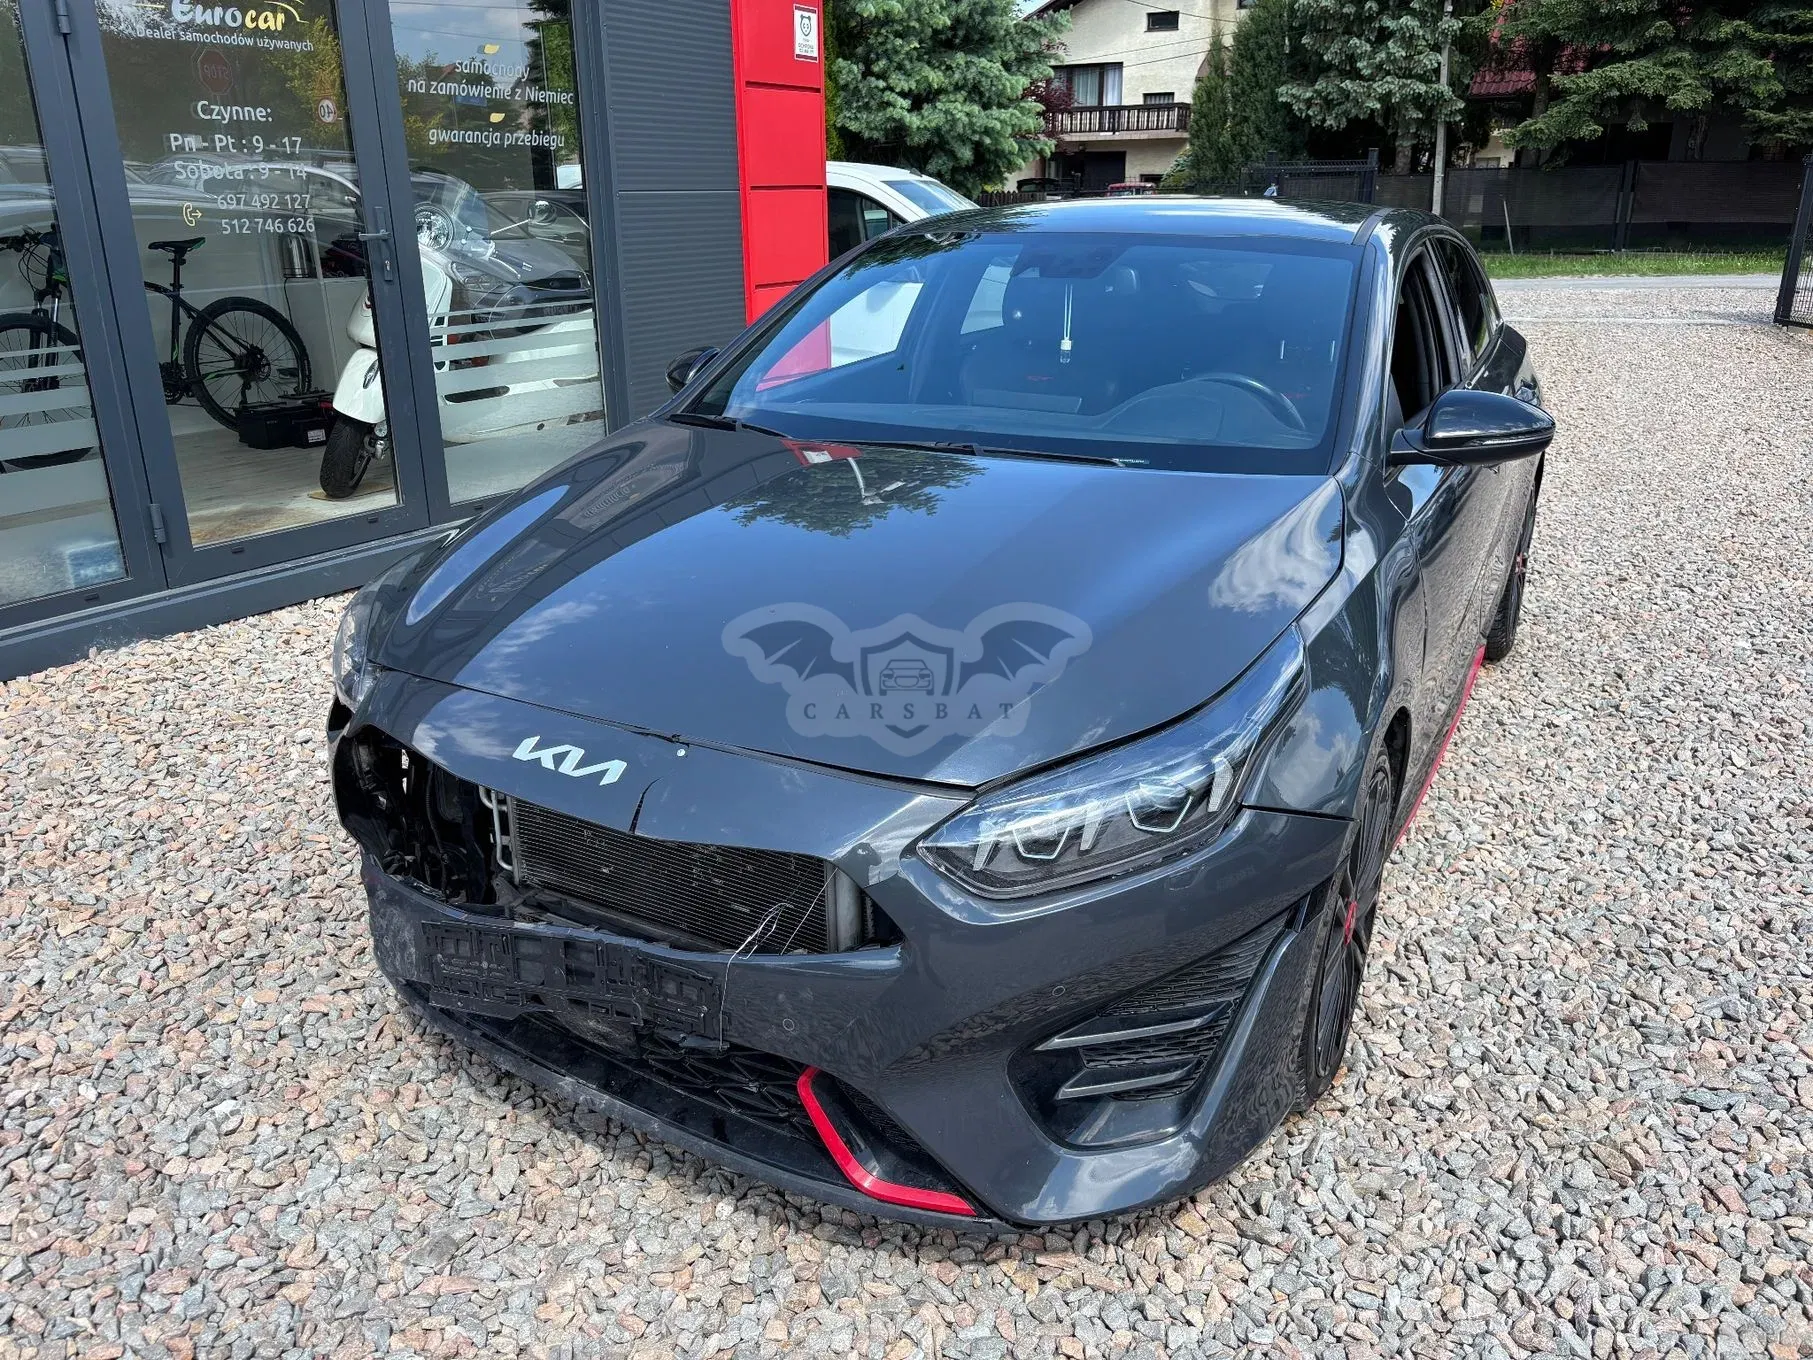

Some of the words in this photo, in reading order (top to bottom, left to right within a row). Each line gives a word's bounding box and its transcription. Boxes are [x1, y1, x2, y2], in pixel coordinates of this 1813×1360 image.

[136, 26, 177, 40] Dealer
[179, 31, 254, 46] samochodów
[256, 36, 314, 51] używanych
[408, 79, 426, 93] na
[430, 79, 512, 100] zamówienie
[515, 88, 522, 100] z
[525, 86, 574, 105] Niemiec
[197, 100, 273, 124] Czynne:
[169, 133, 197, 152] Pn
[214, 134, 237, 153] Pt
[253, 135, 264, 153] 9
[281, 136, 302, 154] 17
[429, 128, 500, 147] gwarancja
[504, 129, 565, 150] przebiegu
[174, 161, 244, 180] Sobota
[259, 163, 270, 179] 9
[217, 194, 246, 209] 697
[251, 194, 281, 209] 492
[284, 194, 311, 209] 127
[221, 218, 251, 234] 512
[254, 218, 284, 233] 746
[288, 217, 315, 233] 626
